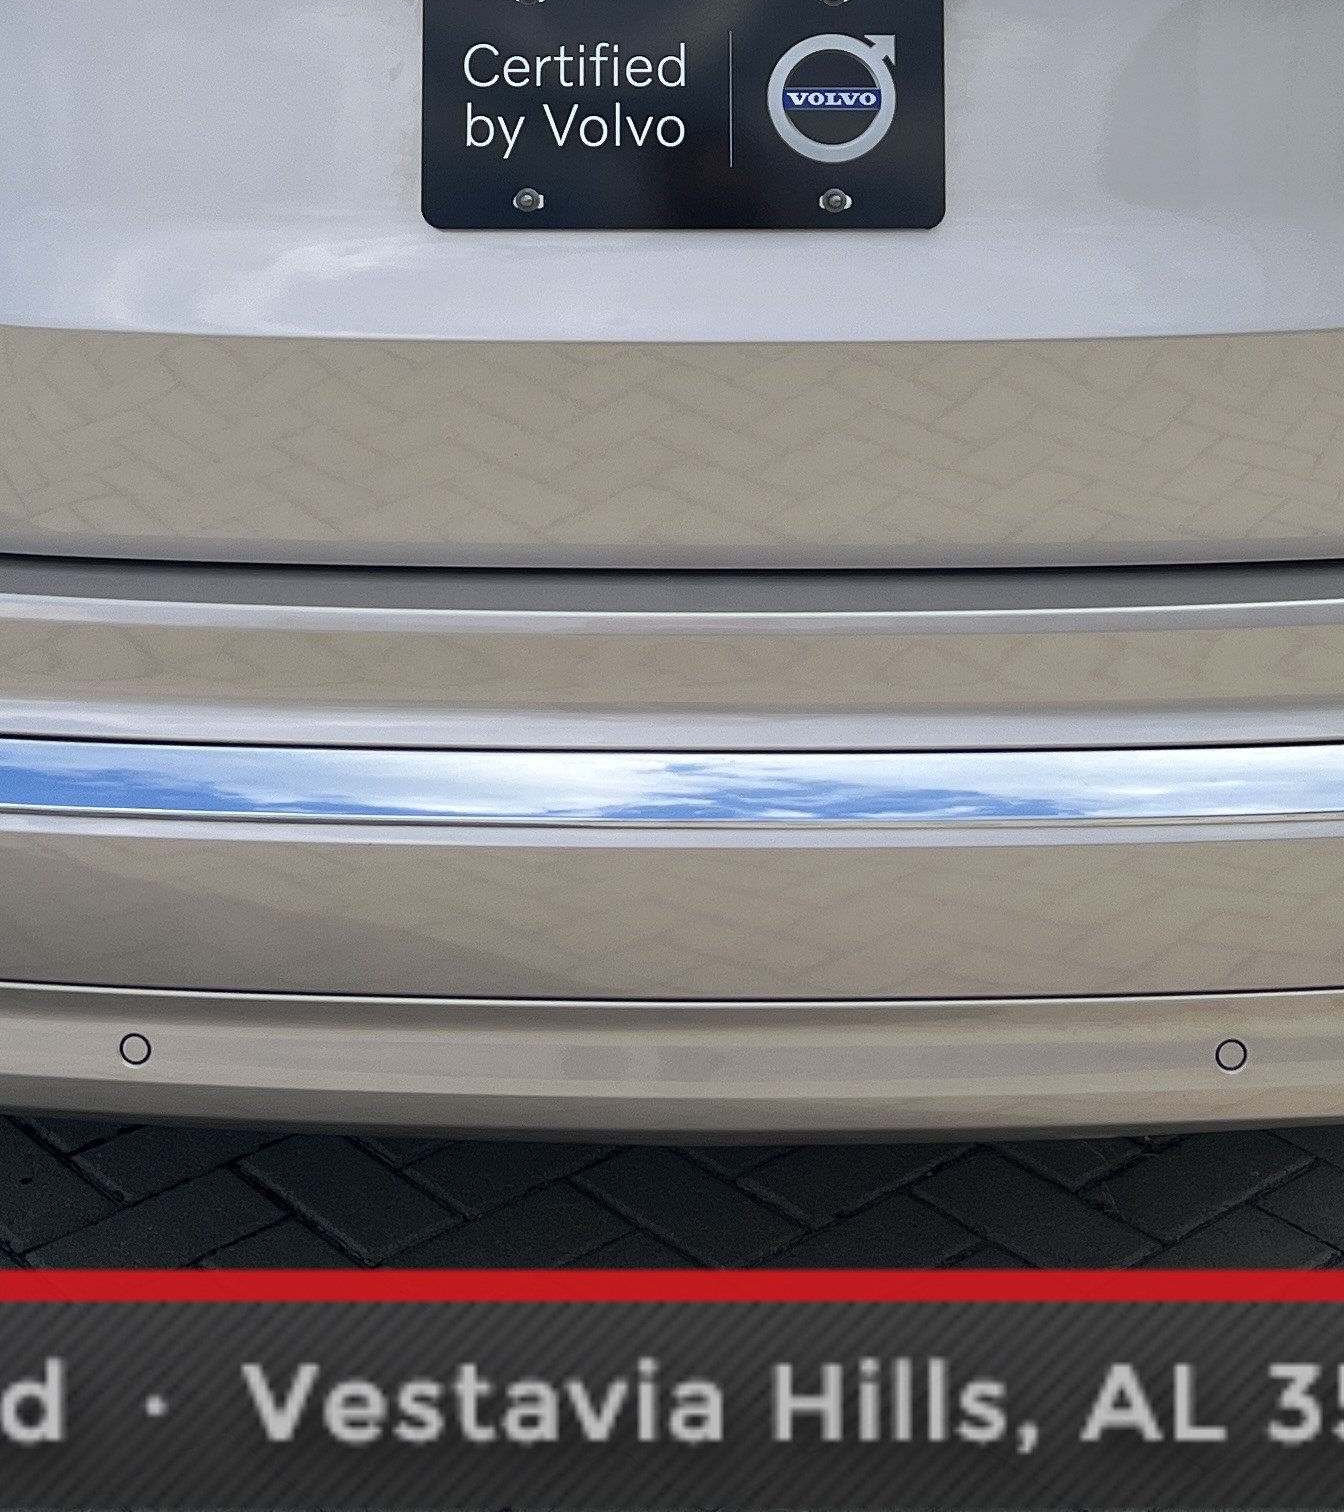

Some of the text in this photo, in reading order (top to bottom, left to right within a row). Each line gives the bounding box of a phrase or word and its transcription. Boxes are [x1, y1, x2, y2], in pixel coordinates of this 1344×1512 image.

[463, 42, 687, 88] Certified
[786, 91, 878, 107] VOLVO
[465, 102, 686, 159] by Volvo
